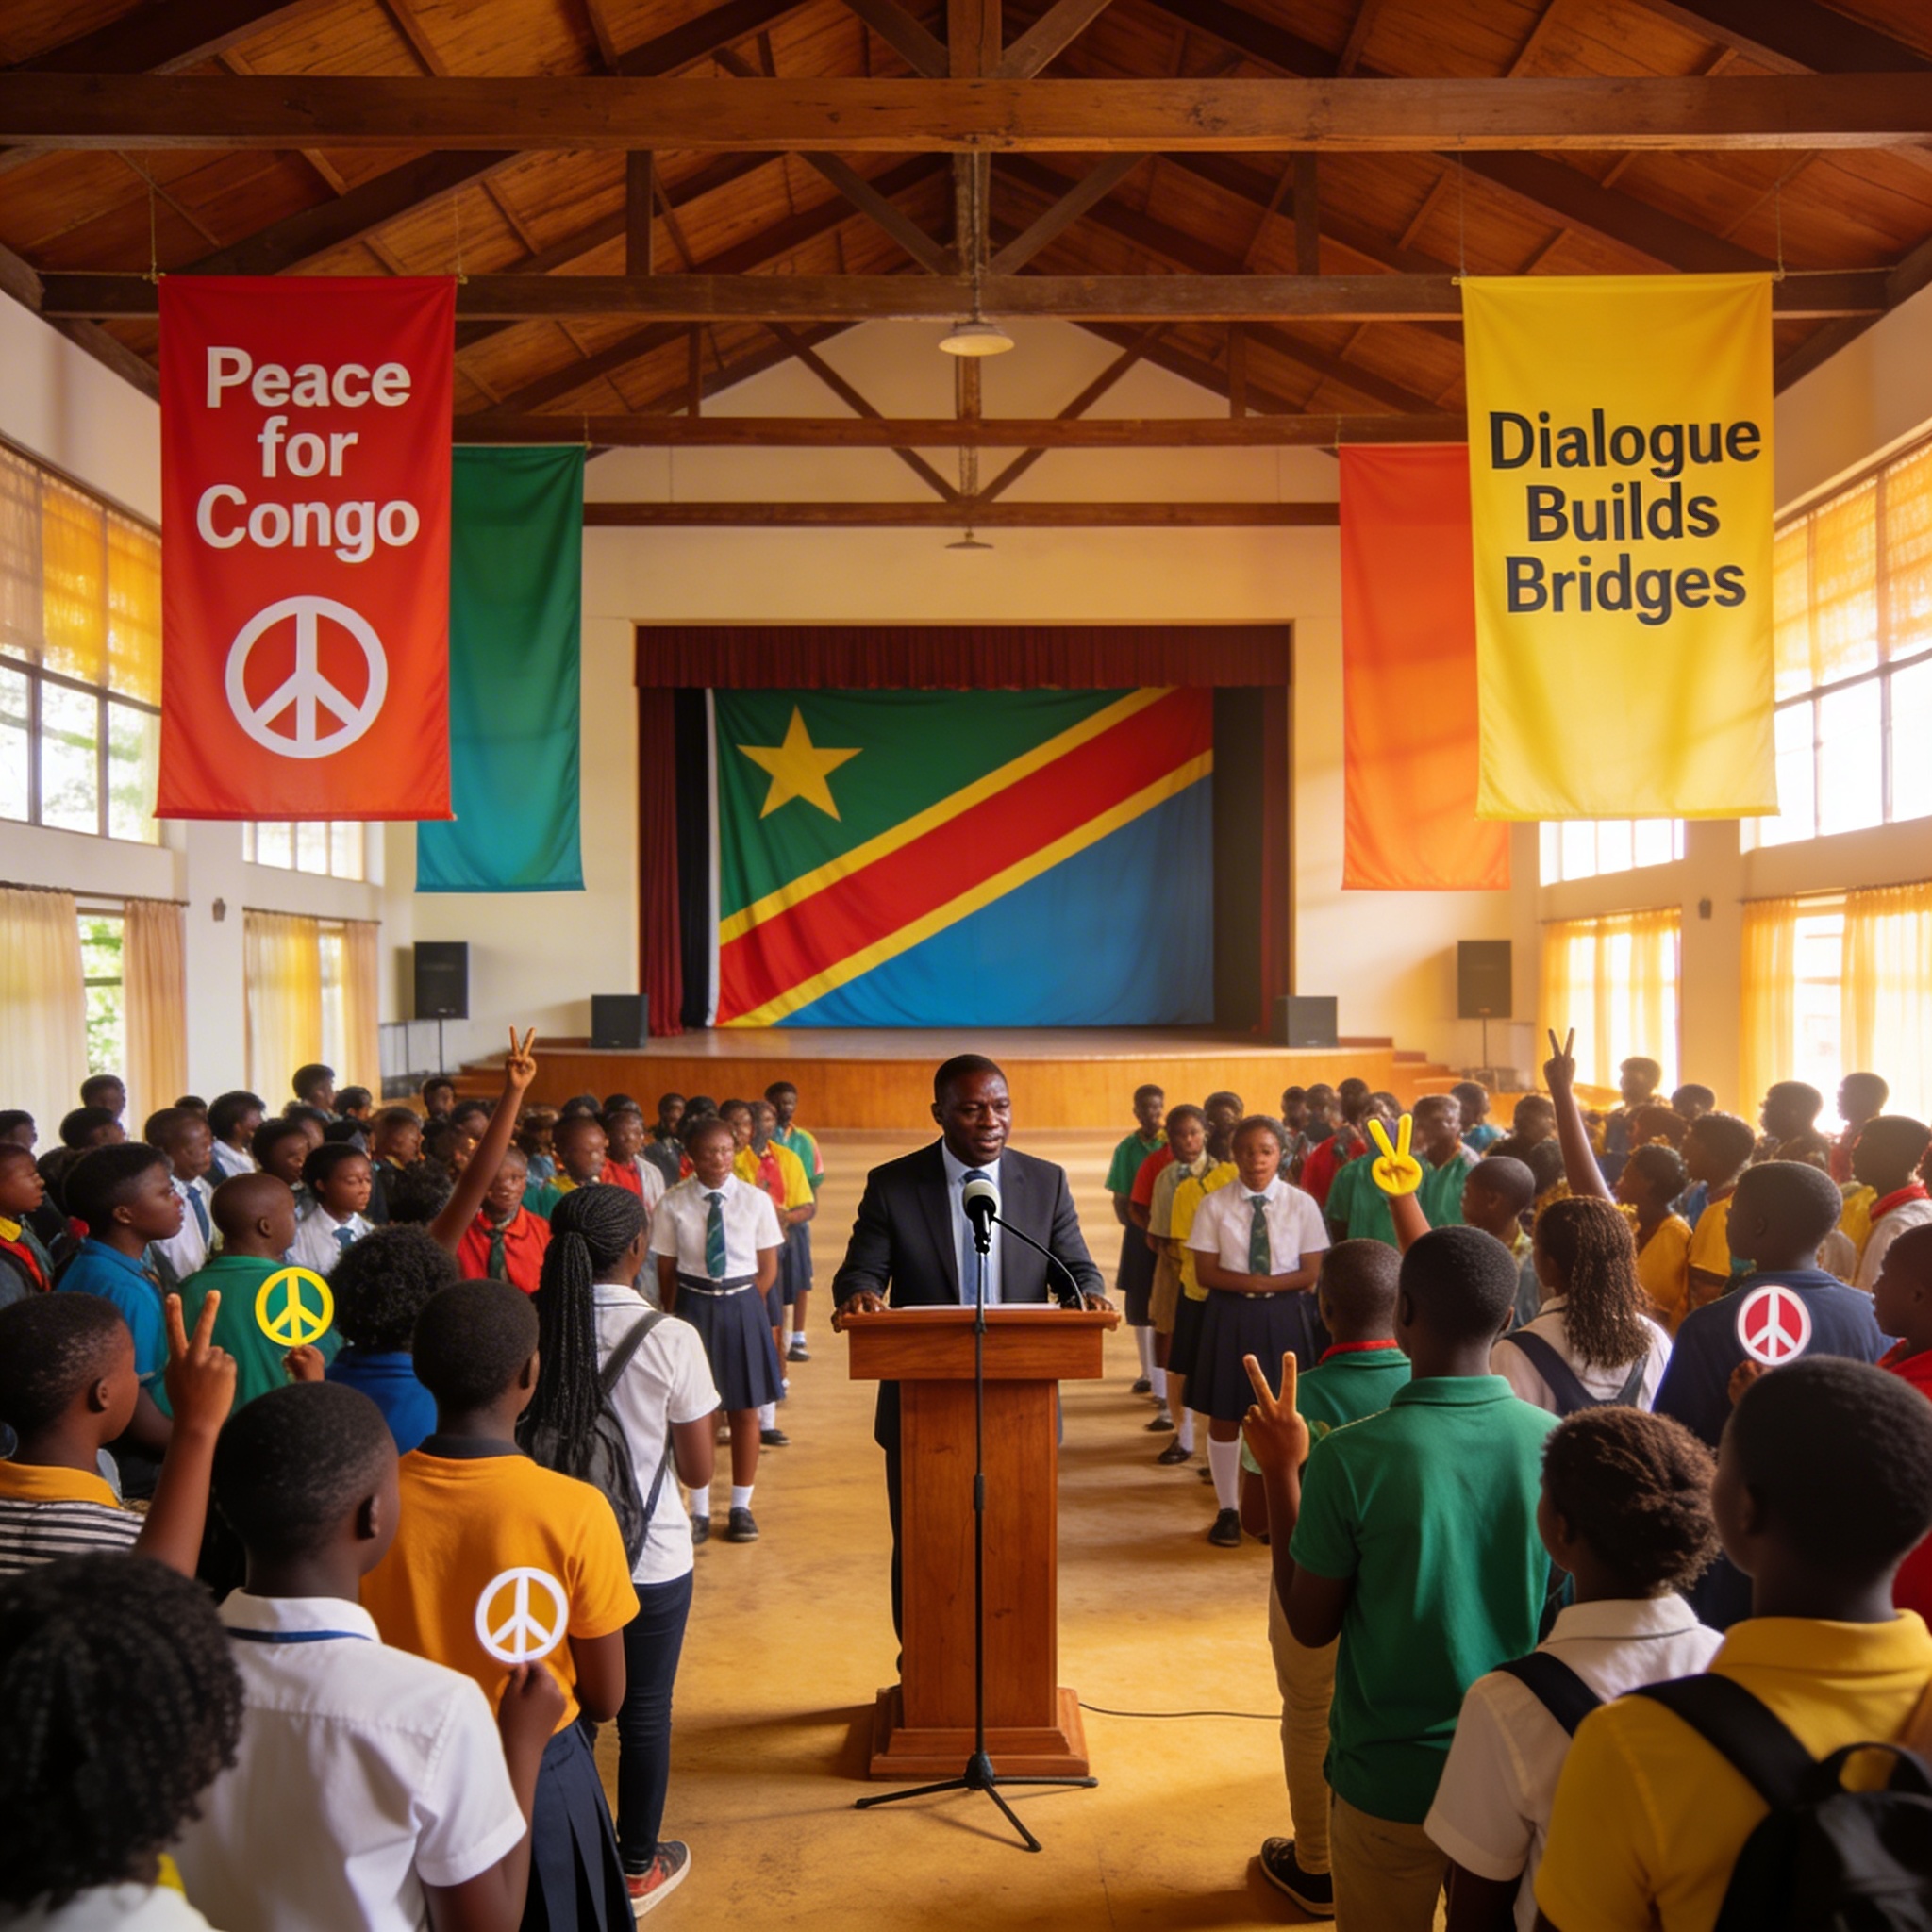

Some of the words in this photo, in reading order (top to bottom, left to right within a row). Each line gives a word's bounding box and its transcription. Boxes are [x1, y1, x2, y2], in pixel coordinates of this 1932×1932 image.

[206, 346, 410, 408] Peace
[257, 415, 358, 478] for
[1489, 408, 1761, 479] Dialogue
[196, 483, 420, 563] Congo
[1526, 480, 1720, 542] Builds
[1506, 552, 1747, 625] Bridges
